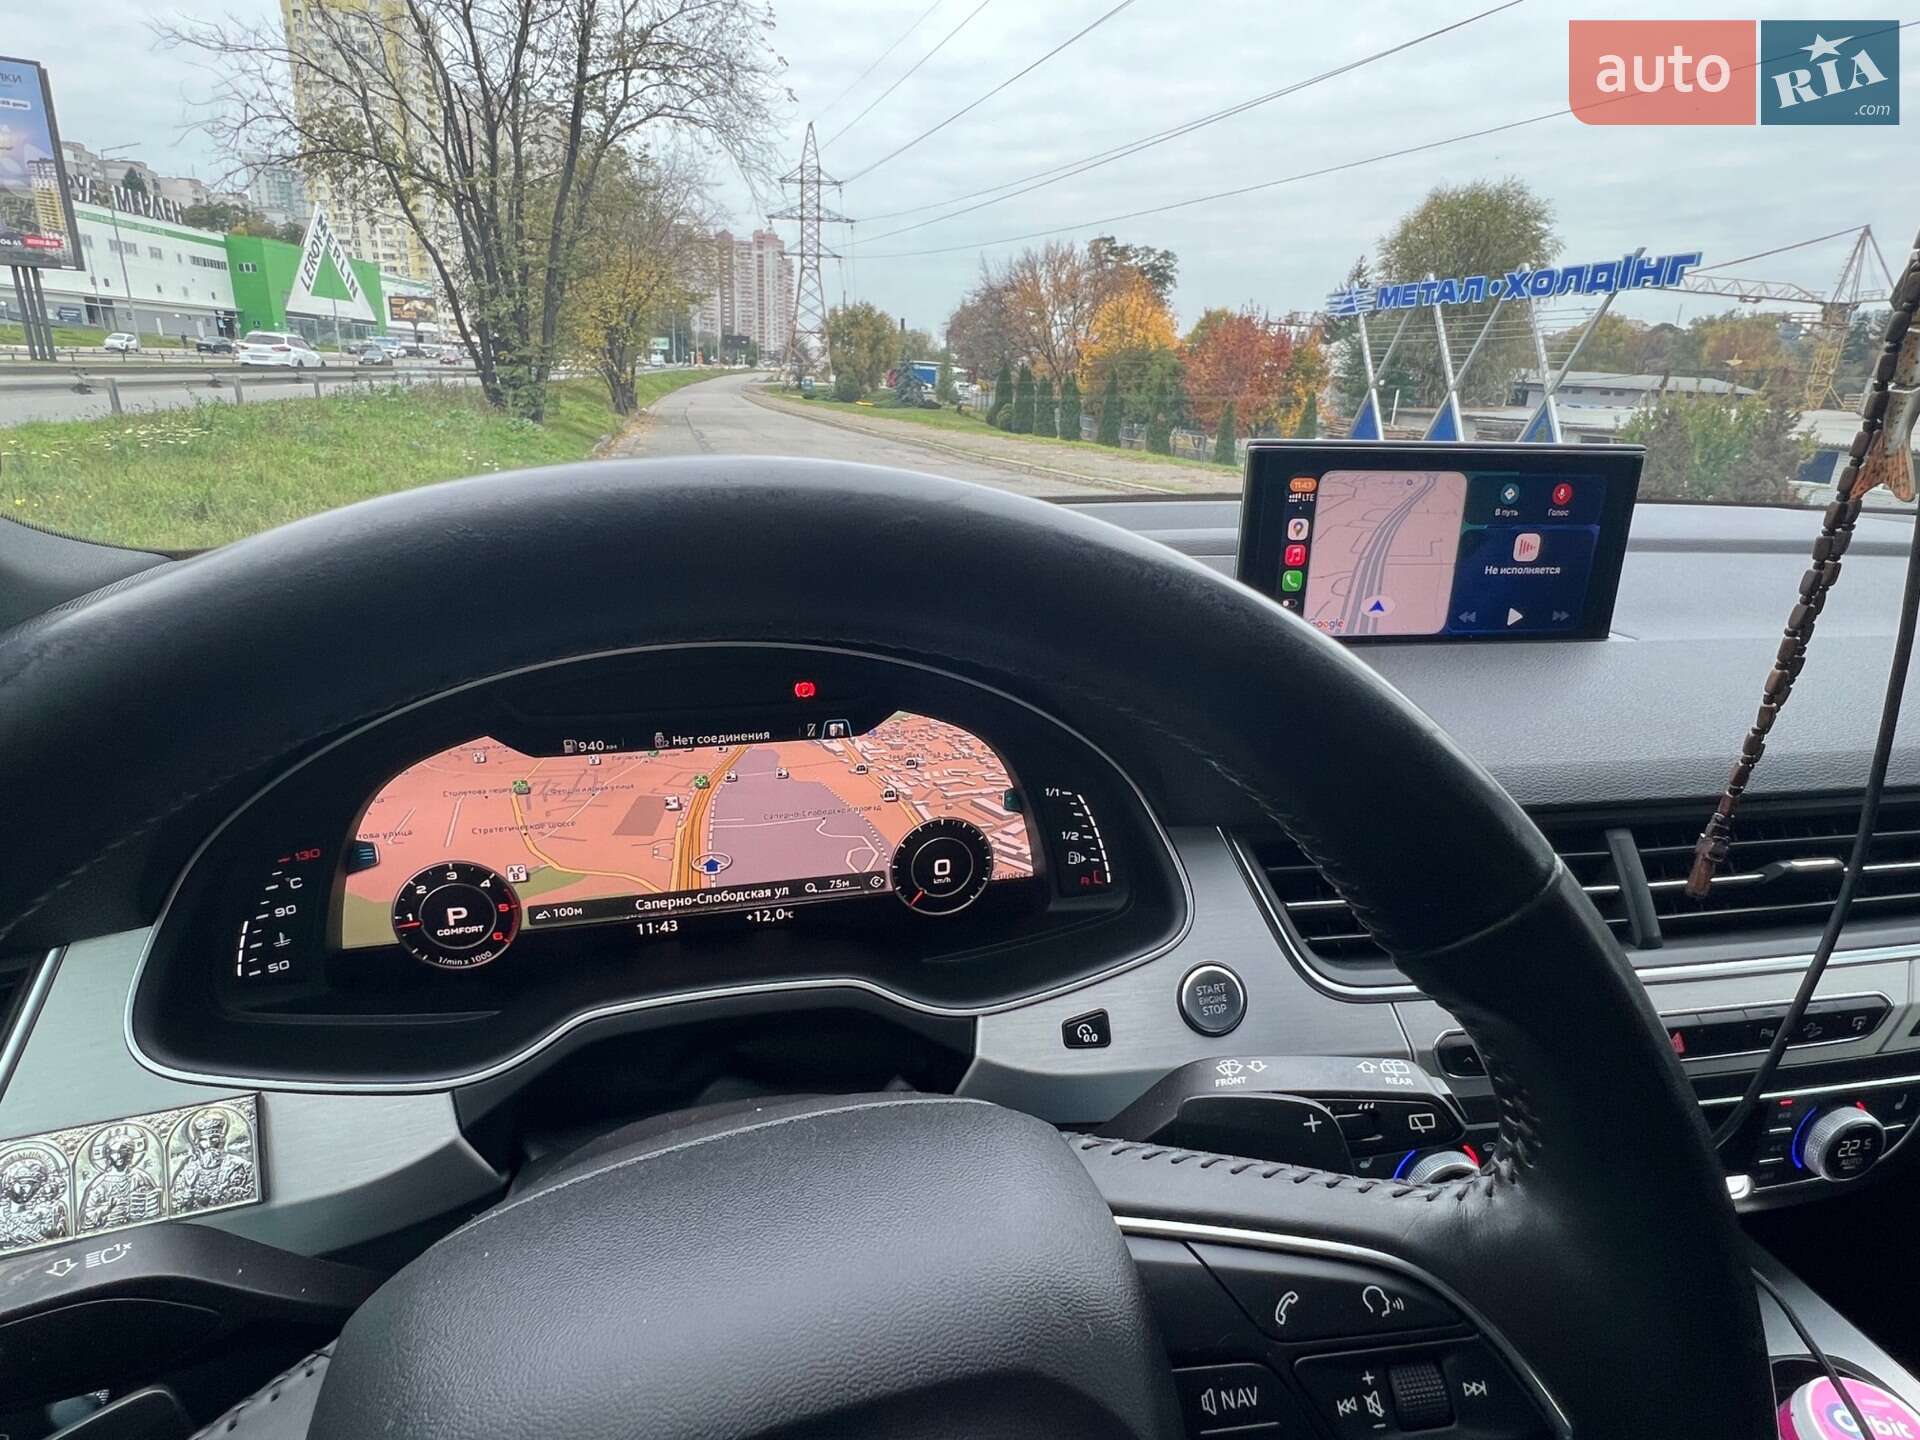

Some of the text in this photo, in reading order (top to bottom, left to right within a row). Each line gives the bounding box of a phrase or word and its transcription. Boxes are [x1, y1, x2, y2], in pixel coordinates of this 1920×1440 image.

[317, 214, 359, 299] MERLIN
[1302, 493, 1315, 502] LTE
[1548, 508, 1569, 517] Голос
[1484, 565, 1561, 575] Не исполняется
[672, 731, 771, 746] Нет соединения
[578, 740, 605, 752] 940
[1045, 787, 1061, 798] 1/1
[1061, 831, 1080, 842] 1/2
[294, 848, 321, 862] 130
[934, 858, 951, 876] 0
[446, 871, 458, 881] 3
[932, 877, 952, 886] km/h
[415, 885, 428, 895] 2
[480, 879, 491, 889] 4
[635, 886, 790, 911] Саперно-Слободская ул
[274, 904, 297, 918] 90
[406, 912, 414, 922] 1
[446, 906, 469, 927] P
[552, 906, 584, 918] 100м
[436, 925, 485, 938] COMFORT
[636, 919, 679, 936] 11:43
[438, 955, 464, 967] 1/min
[471, 949, 493, 964] 1000
[267, 959, 290, 974] 50
[1195, 982, 1227, 996] START
[1202, 1003, 1228, 1016] STOP
[1215, 1075, 1248, 1088] FRONT
[1384, 1075, 1415, 1087] REAR
[1220, 1385, 1259, 1411] NAV
[1832, 1408, 1915, 1440] Obit
